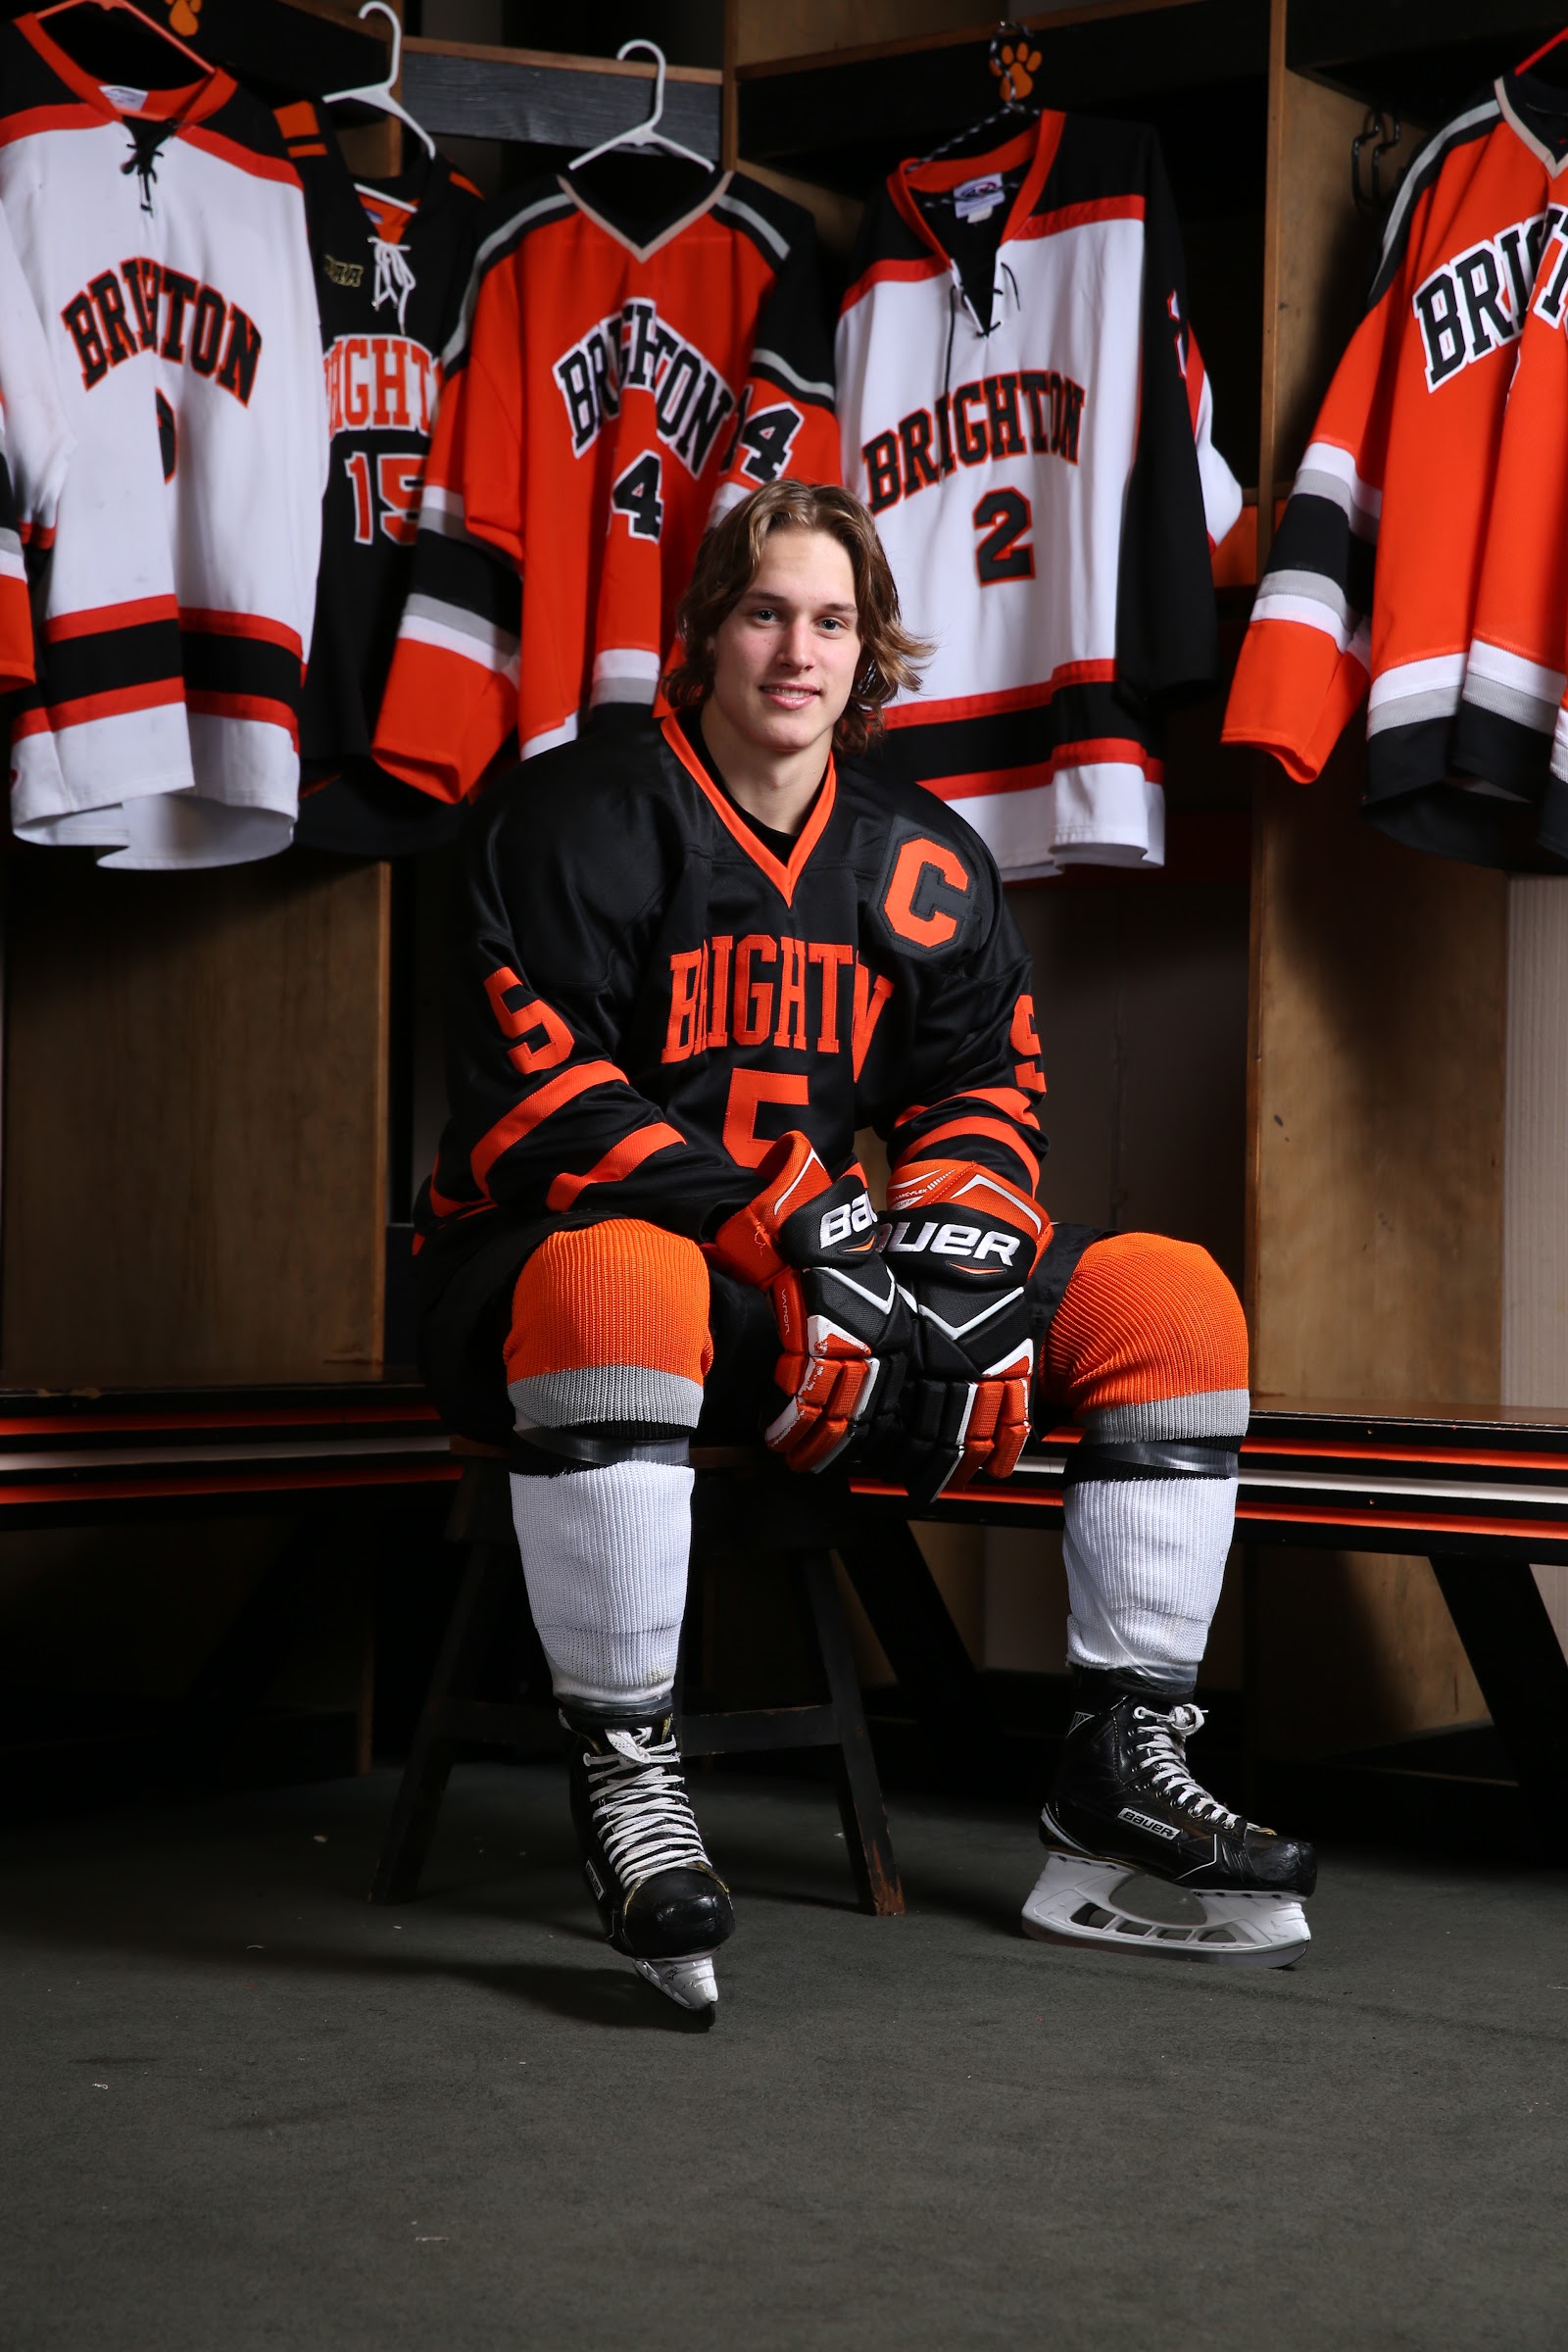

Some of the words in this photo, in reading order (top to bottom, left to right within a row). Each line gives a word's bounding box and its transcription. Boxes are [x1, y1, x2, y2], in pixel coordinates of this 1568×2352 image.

[61, 257, 262, 409] BRITON
[344, 451, 427, 545] 15
[861, 369, 1086, 517] BRIGHTON
[972, 486, 1036, 587] 2
[884, 837, 968, 948] C
[483, 966, 575, 1075] 5
